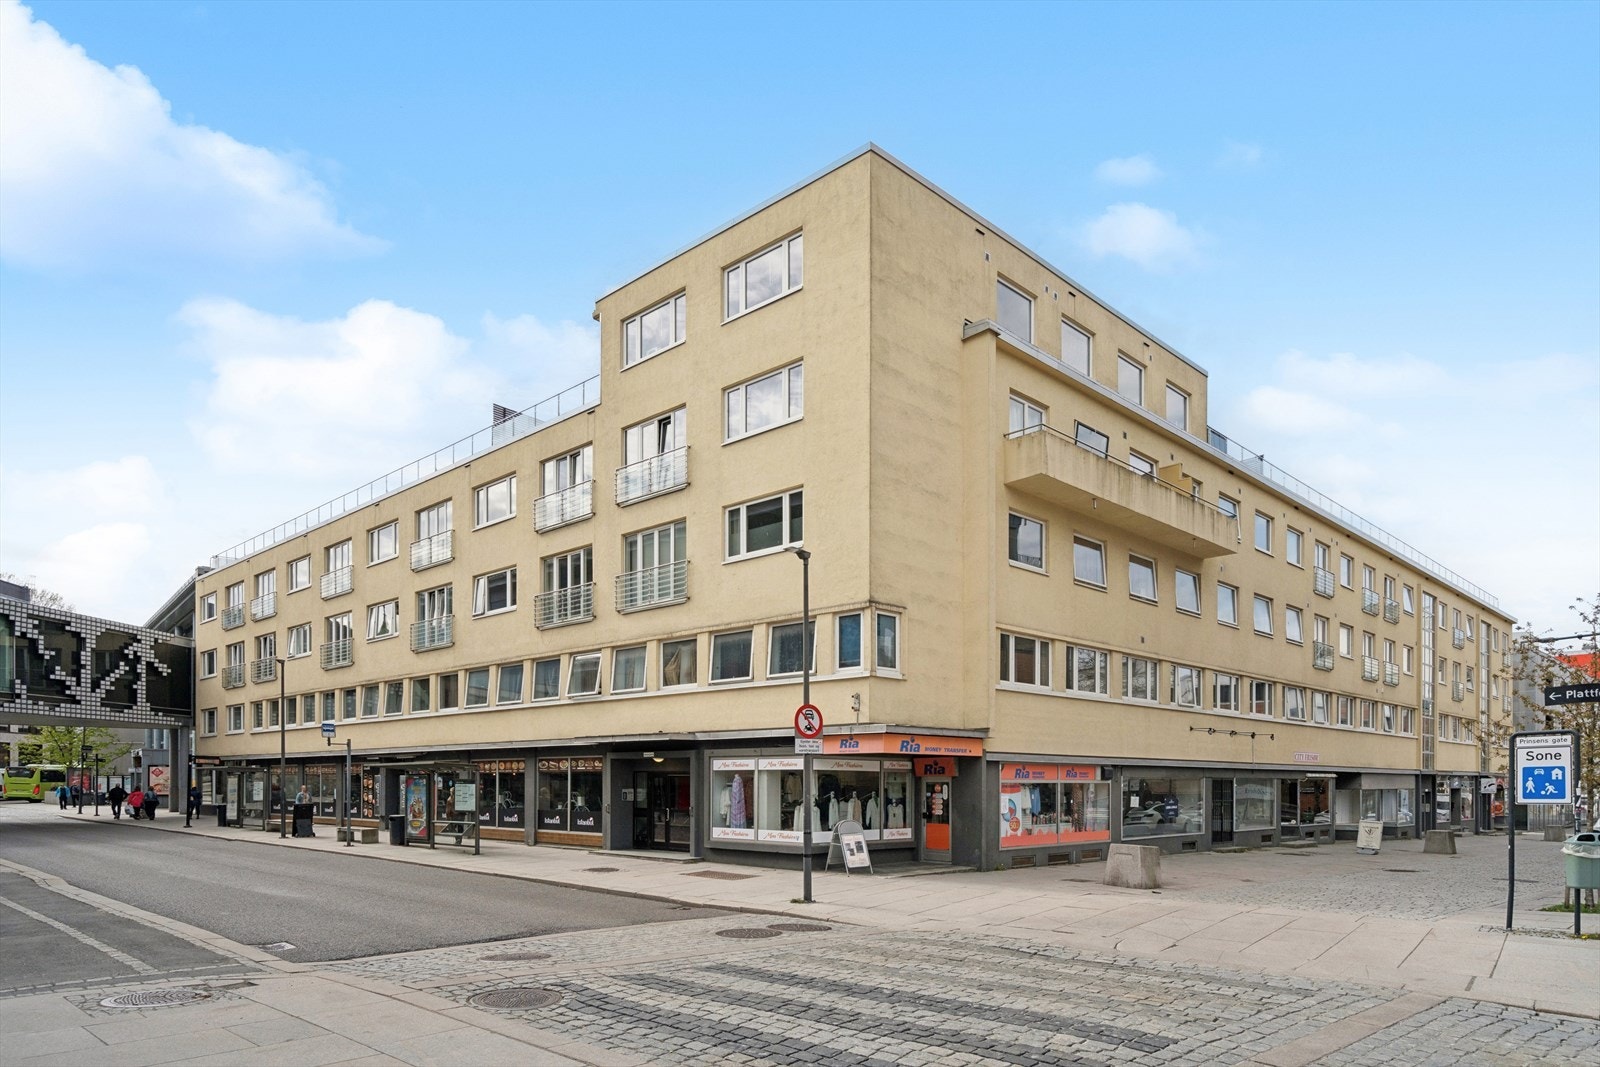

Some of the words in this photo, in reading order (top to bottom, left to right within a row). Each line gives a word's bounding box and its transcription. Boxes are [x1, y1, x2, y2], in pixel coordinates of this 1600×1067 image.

[839, 736, 859, 748] Ria
[899, 737, 921, 753] Ria
[1526, 751, 1562, 761] Sone
[924, 761, 946, 775] Ria
[1014, 766, 1030, 779] Ria
[1066, 768, 1078, 778] Ria
